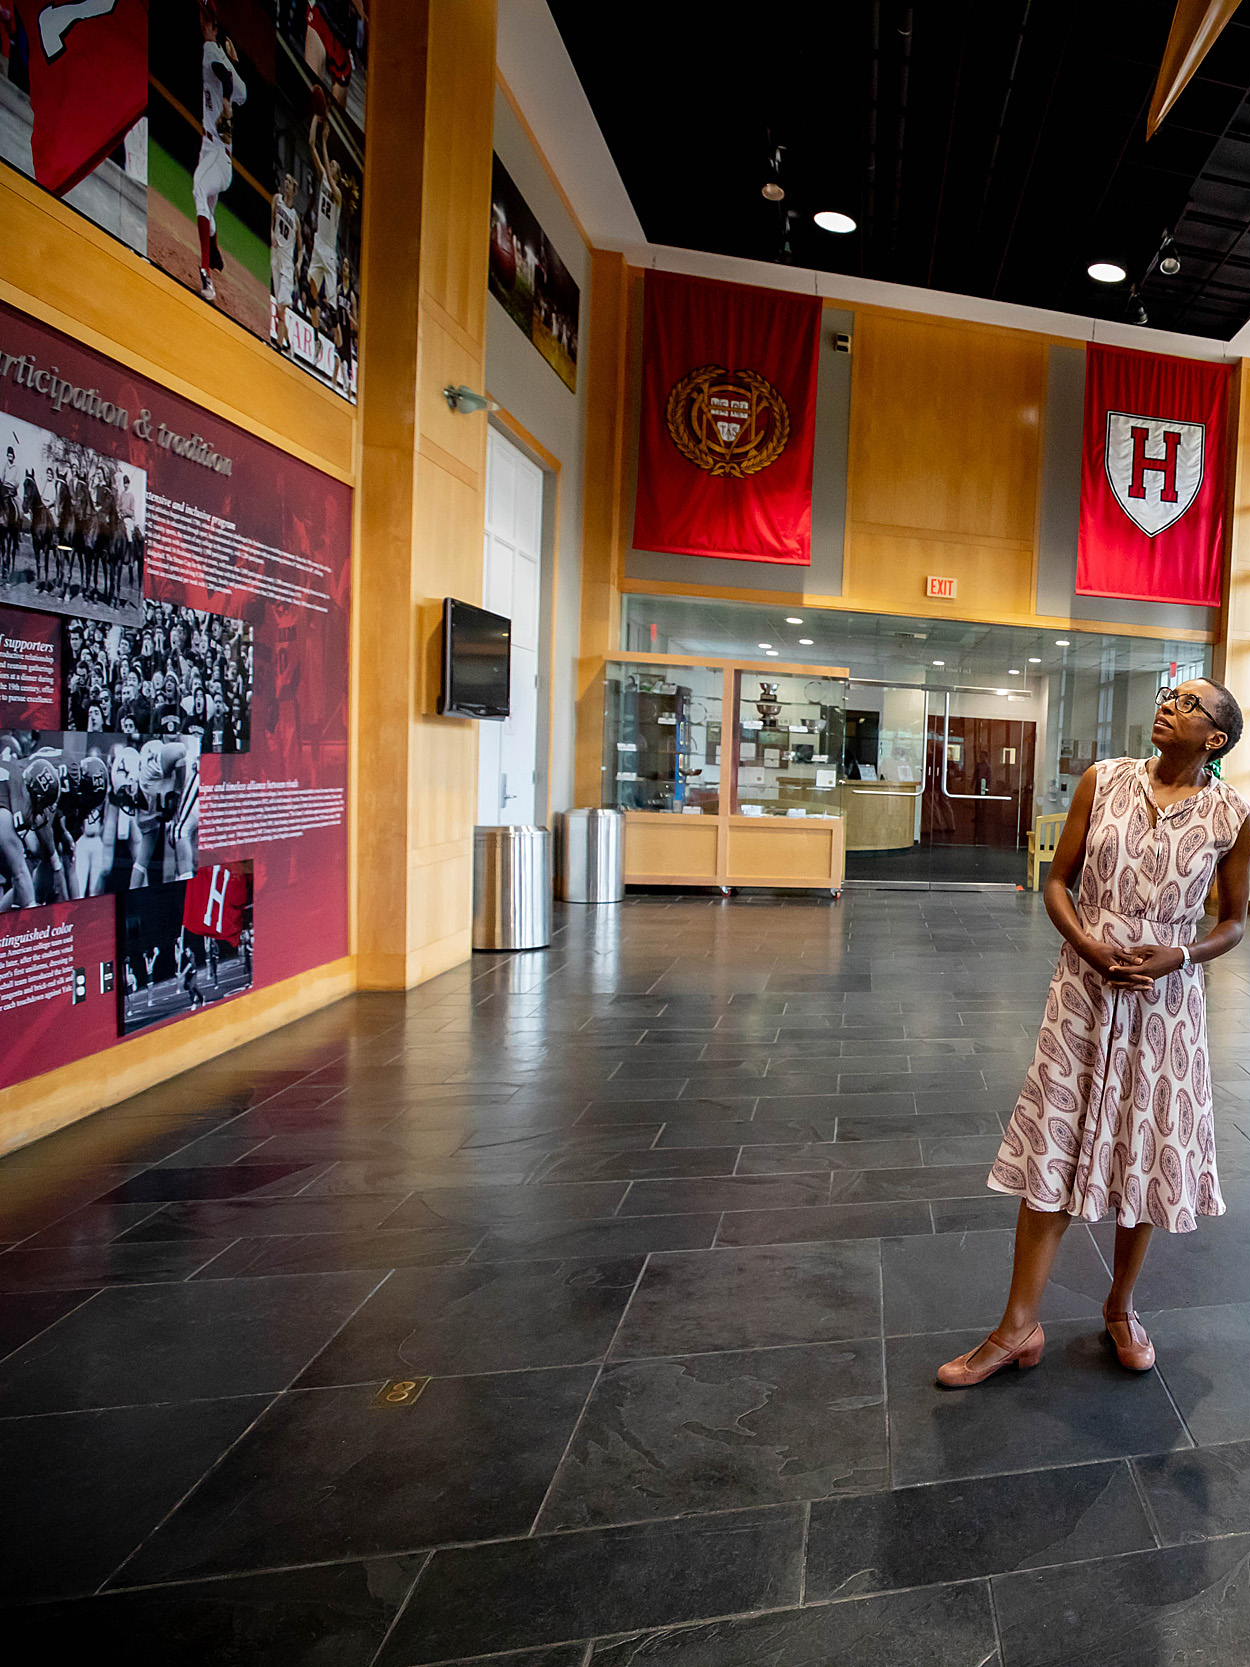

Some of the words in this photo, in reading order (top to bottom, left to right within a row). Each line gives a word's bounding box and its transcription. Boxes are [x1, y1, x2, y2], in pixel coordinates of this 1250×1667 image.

[133, 408, 154, 442] &
[157, 423, 232, 477] tradition
[1127, 425, 1182, 504] H
[930, 578, 954, 597] EXIT
[4, 639, 54, 652] supporters
[202, 864, 231, 934] H
[51, 921, 74, 937] color
